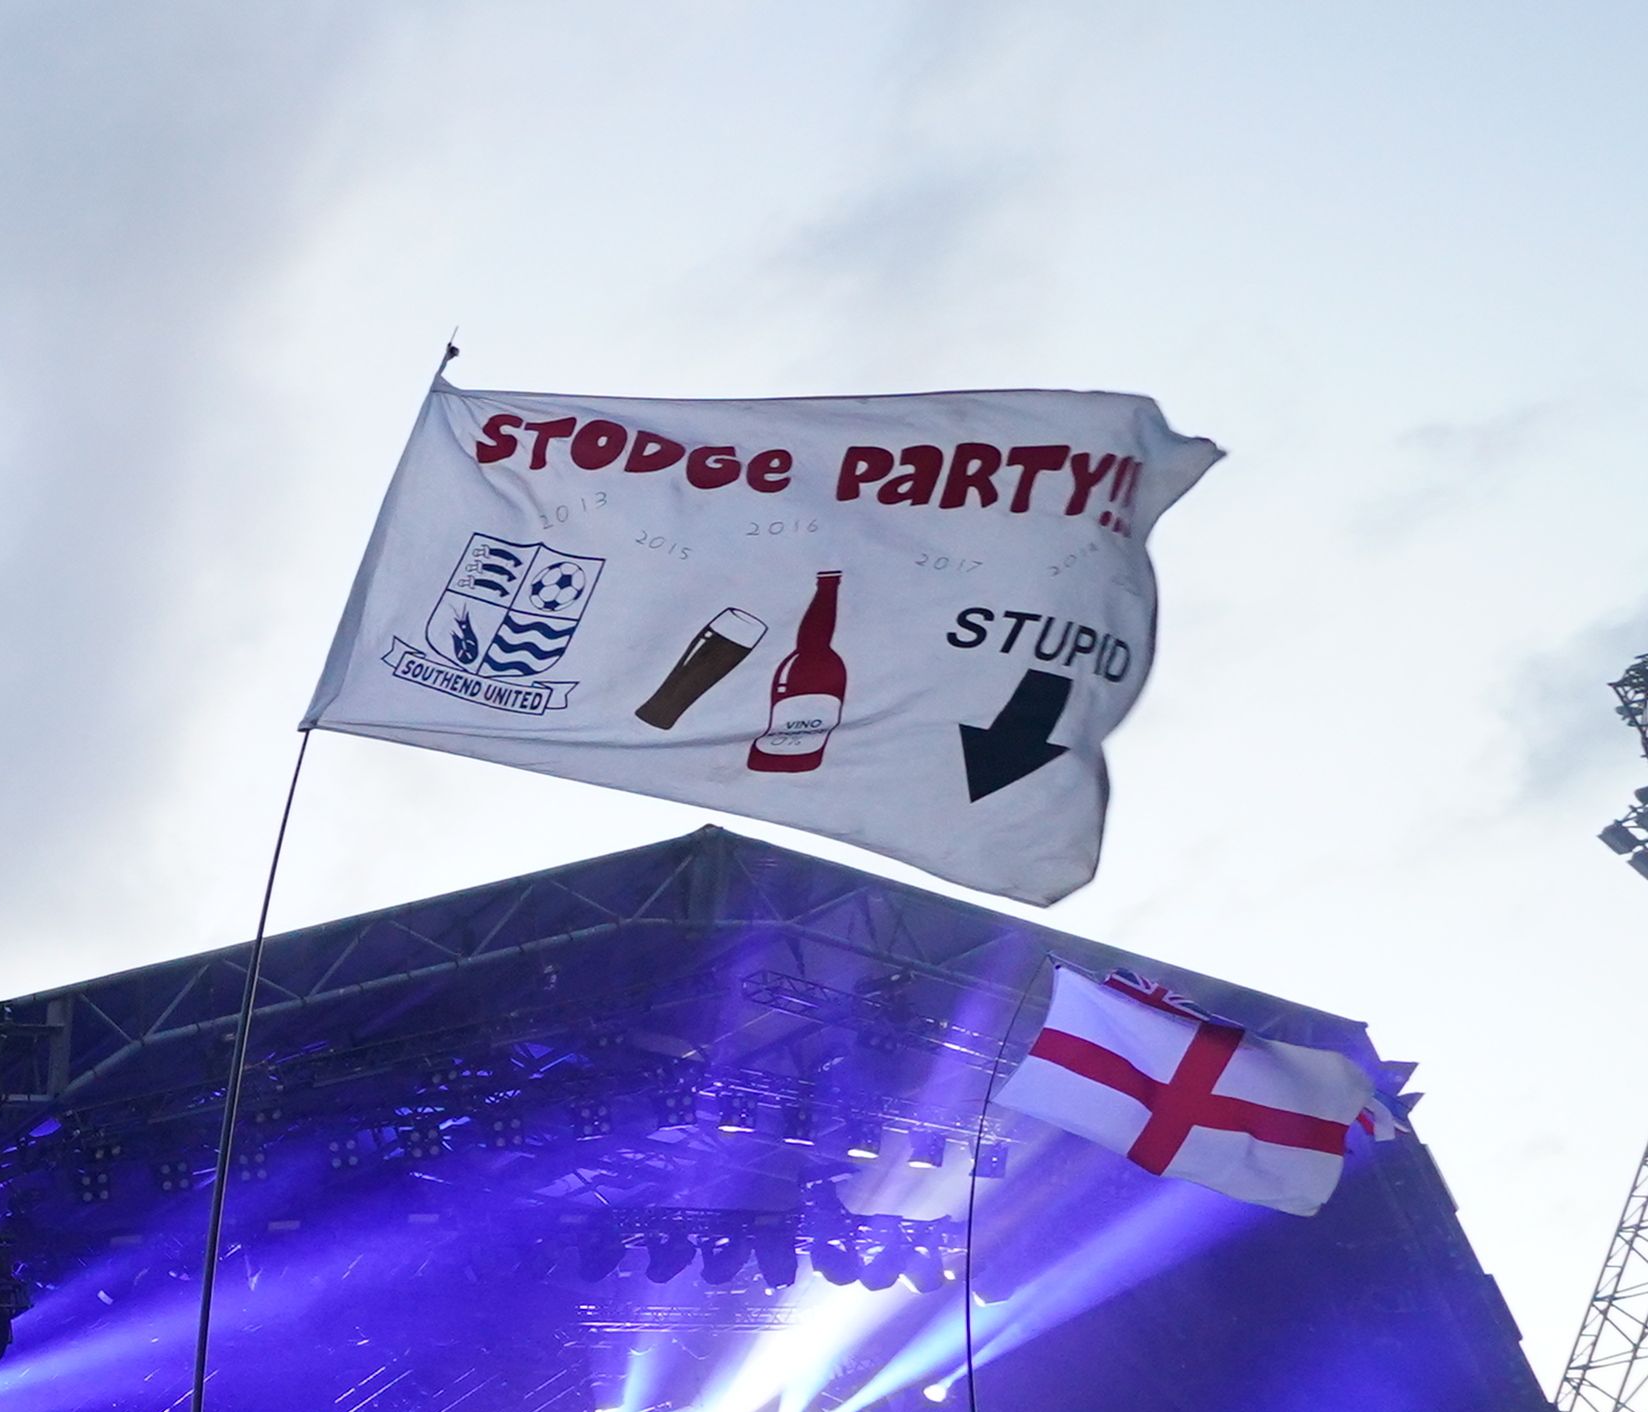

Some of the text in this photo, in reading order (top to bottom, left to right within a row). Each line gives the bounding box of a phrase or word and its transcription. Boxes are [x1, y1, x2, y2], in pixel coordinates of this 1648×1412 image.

[540, 491, 608, 530] 2013
[745, 518, 819, 537] 2016
[634, 530, 692, 560] 2015
[915, 553, 983, 574] 2017
[945, 606, 1131, 683] STUPID
[401, 659, 543, 711] SOUTHEND UNITED
[786, 719, 823, 729] VINO
